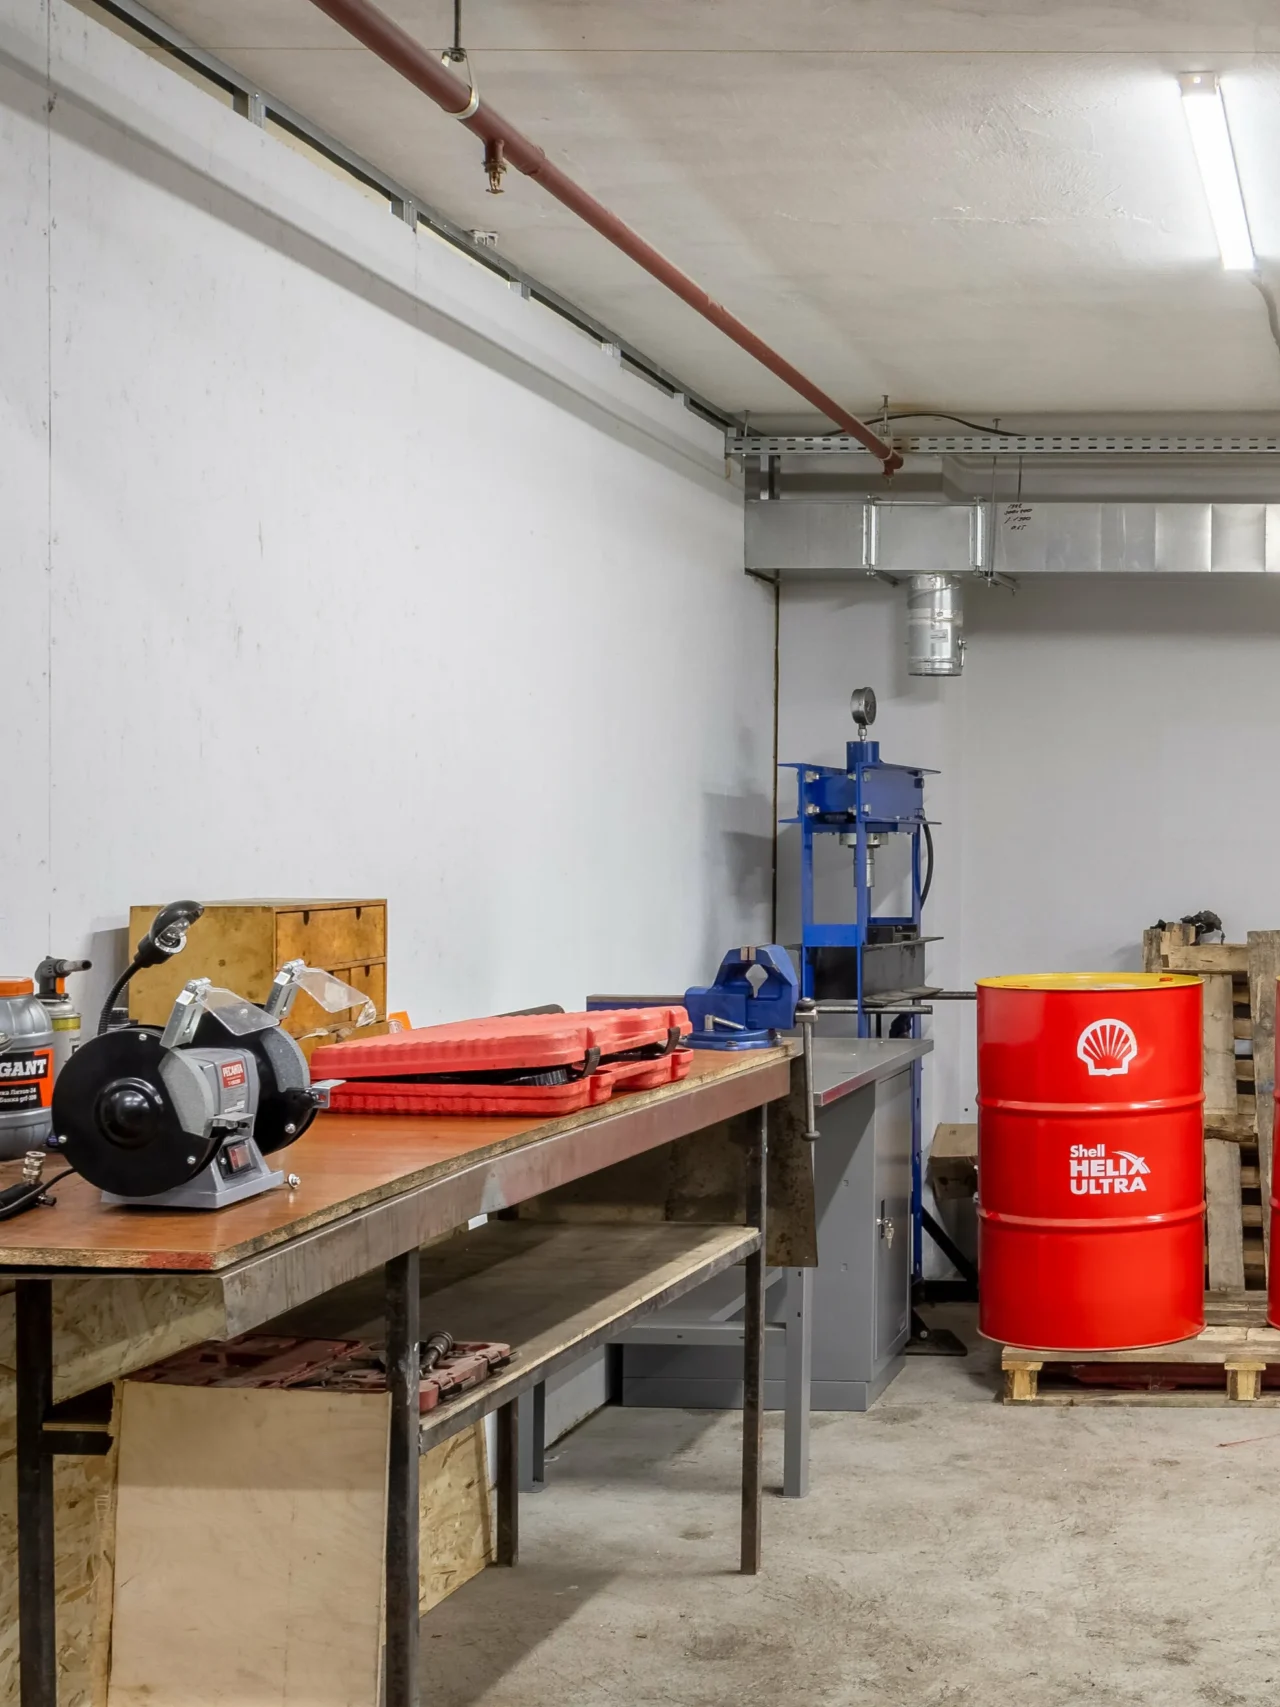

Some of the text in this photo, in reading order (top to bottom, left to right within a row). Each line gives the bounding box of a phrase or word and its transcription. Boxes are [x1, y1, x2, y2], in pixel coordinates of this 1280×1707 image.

[1070, 1144, 1105, 1158] Shell
[1069, 1151, 1151, 1177] HELIX
[1070, 1177, 1147, 1195] ULTRA
